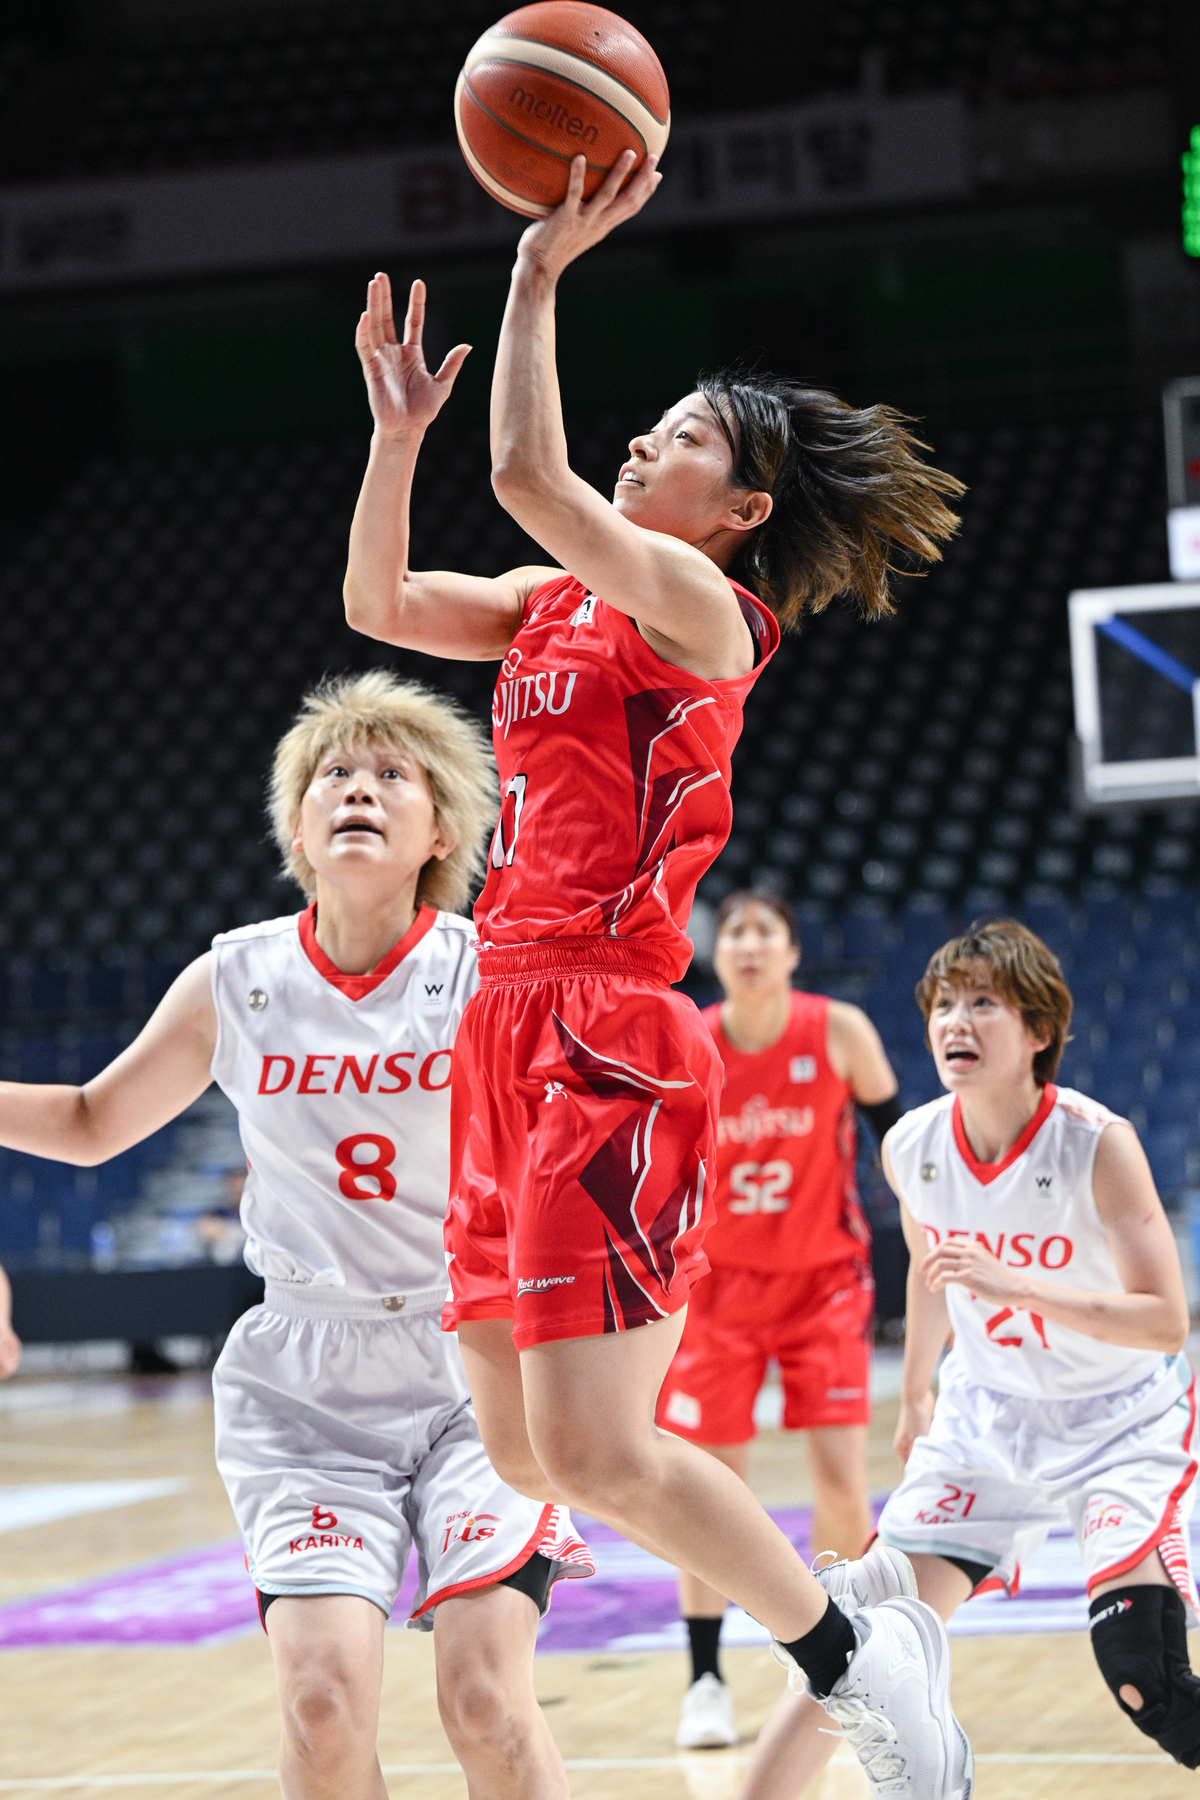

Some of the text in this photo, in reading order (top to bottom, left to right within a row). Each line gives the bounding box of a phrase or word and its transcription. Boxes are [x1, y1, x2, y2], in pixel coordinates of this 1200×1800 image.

[509, 87, 599, 144] molten
[492, 671, 579, 740] UJITSU
[257, 1048, 453, 1095] DENSO
[335, 1133, 397, 1202] 8
[517, 1275, 576, 1291] Red Wave
[936, 1484, 976, 1517] 21
[289, 1534, 364, 1555] KARIYA
